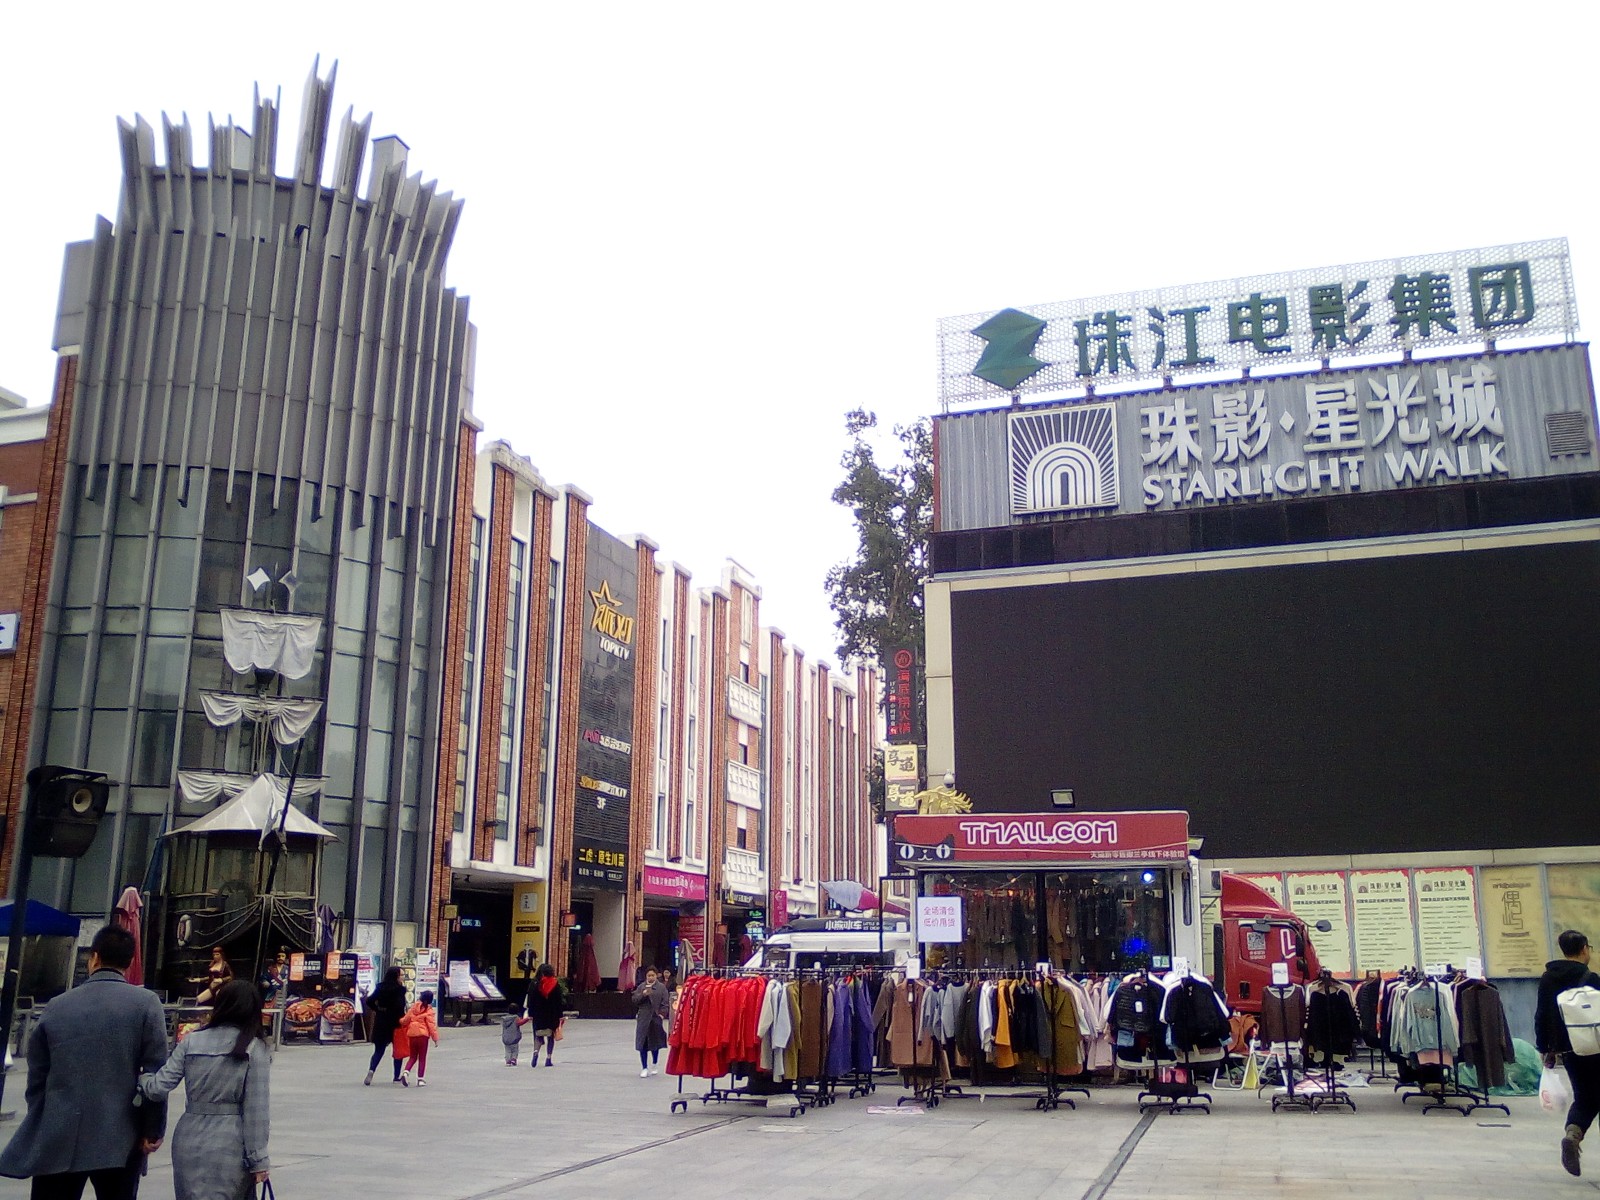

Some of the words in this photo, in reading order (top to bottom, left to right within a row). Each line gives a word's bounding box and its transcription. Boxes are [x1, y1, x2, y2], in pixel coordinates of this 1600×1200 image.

[1074, 261, 1536, 377] 珠江电影集团
[1143, 454, 1366, 507] STARLIGHT
[1385, 441, 1509, 484] WALK
[959, 820, 1117, 845] TMALL.COM
[923, 906, 955, 916] 全场清仓
